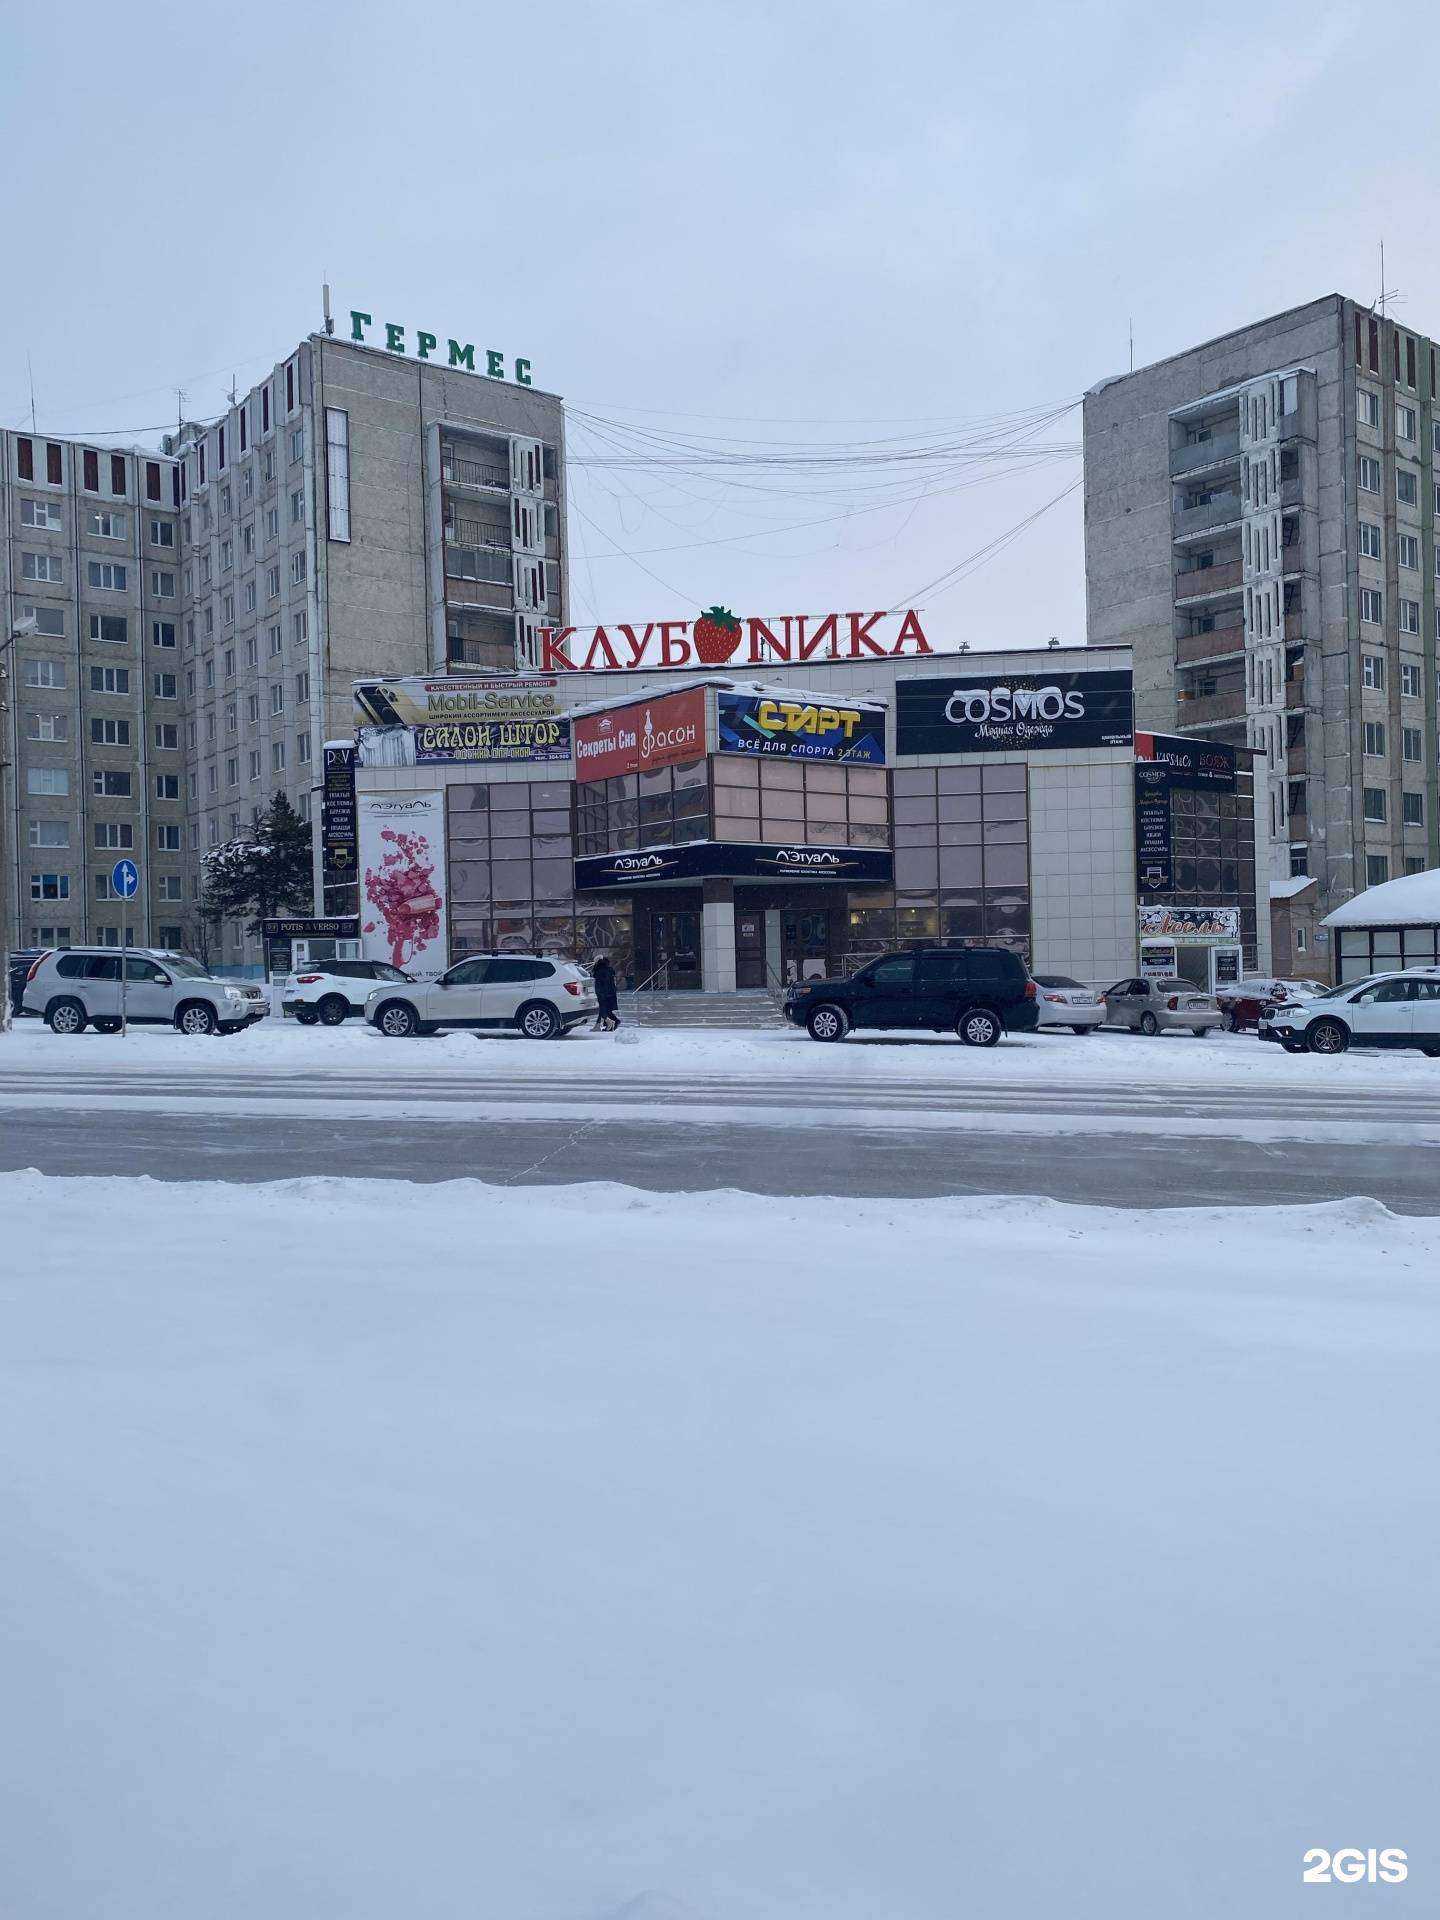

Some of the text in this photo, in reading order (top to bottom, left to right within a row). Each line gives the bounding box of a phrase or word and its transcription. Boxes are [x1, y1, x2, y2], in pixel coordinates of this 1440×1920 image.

[350, 310, 532, 385] ГЕРМЕС
[430, 682, 482, 692] КАЧЕСТВЕННЫЙ
[490, 681, 524, 690] БЫСТРЫЙ
[524, 680, 551, 688] РЕМОНТ
[427, 690, 555, 712] Mobil-Service
[945, 689, 1085, 724] COSMOS
[463, 711, 509, 719] АССОРТИМЕНТ
[758, 700, 860, 738] СТАРТ
[422, 721, 560, 749] САЛОН ШТОР
[576, 730, 636, 759] Секреты Сна
[738, 738, 871, 760] ВСЁ ДЛЯ СПОРТА 2 ЭТАЖ
[281, 923, 304, 931] POTIS
[312, 923, 339, 931] VERSO
